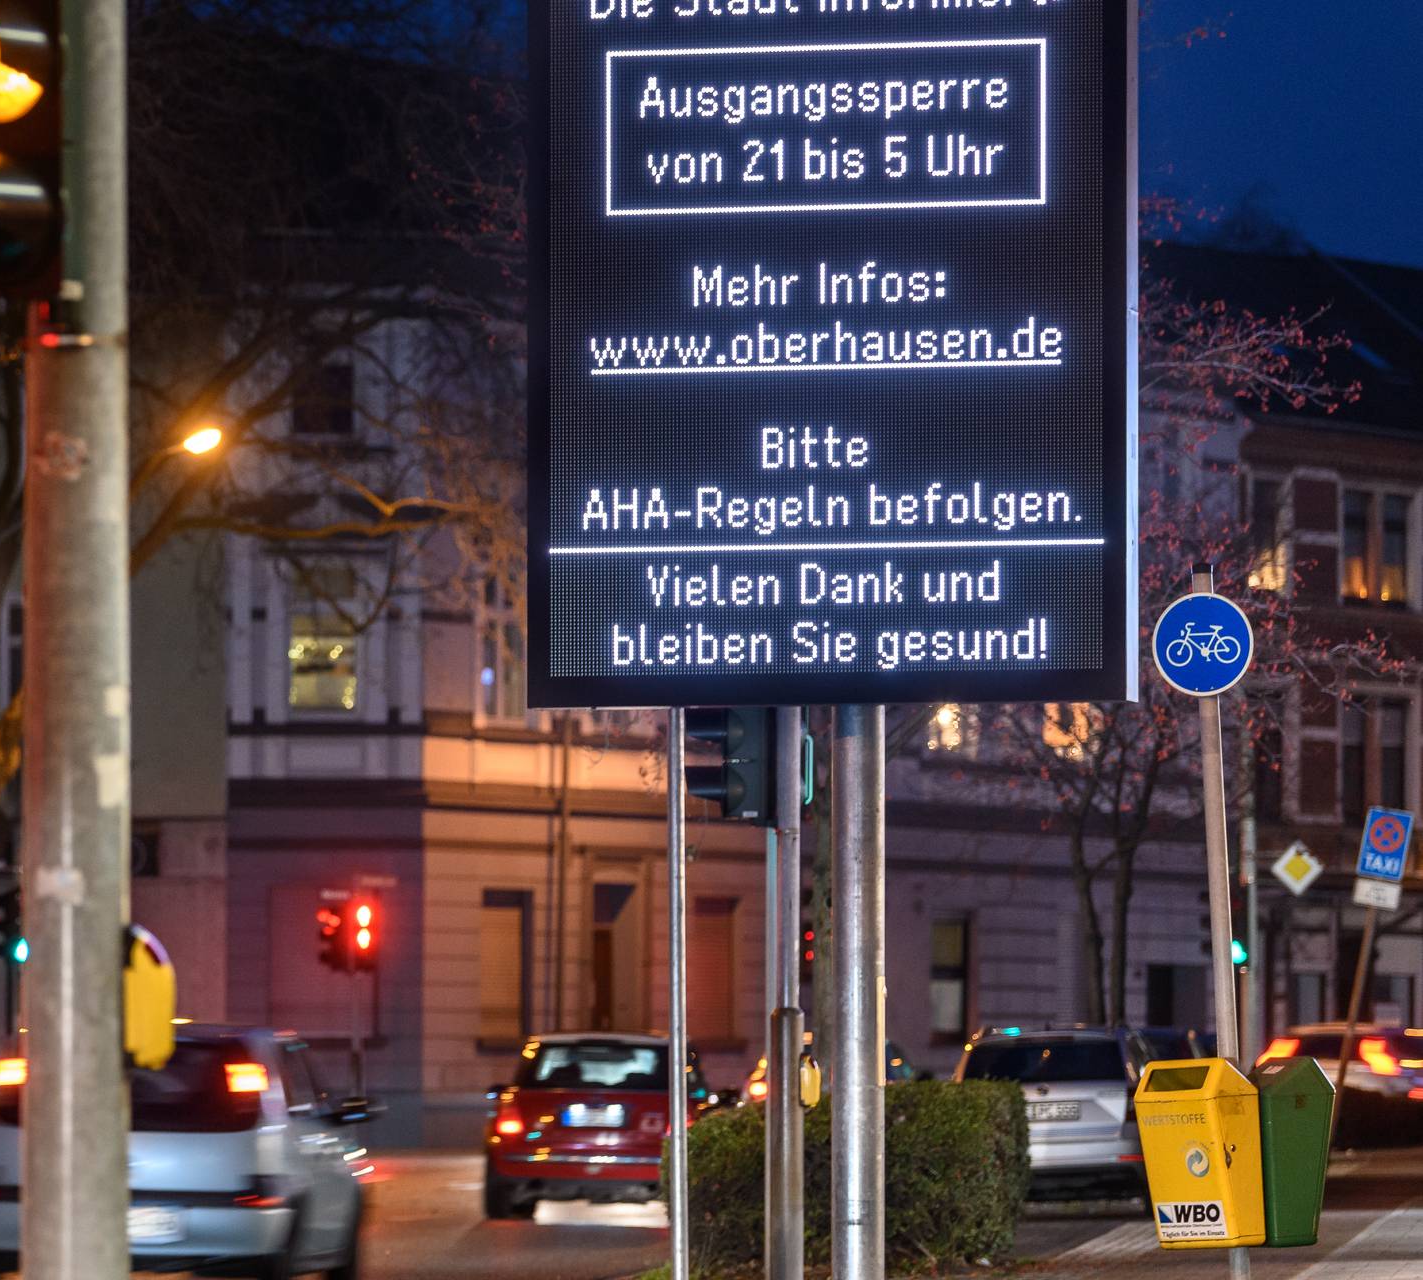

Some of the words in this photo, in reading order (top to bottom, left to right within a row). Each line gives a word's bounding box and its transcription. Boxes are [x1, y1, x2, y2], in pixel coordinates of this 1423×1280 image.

[639, 76, 1008, 123] Ausgangssperre
[647, 152, 722, 184] von
[742, 139, 784, 182] 21
[804, 138, 865, 180] bis
[884, 136, 907, 178] 5
[927, 134, 1004, 177] Uhr
[693, 264, 799, 308] Mehr
[819, 261, 946, 305] Infos:
[590, 316, 1063, 368] www.oberhausen.de
[761, 427, 869, 469] Bitte
[583, 485, 849, 536] AHA-Regeln
[869, 481, 1082, 531] befolgen.
[647, 564, 780, 607] Vielen
[800, 561, 903, 605] Dank
[923, 560, 1000, 603] und
[612, 622, 772, 667] bleiben
[792, 621, 857, 663] Sie
[877, 618, 1047, 669] gesund!
[1365, 852, 1400, 874] TAXI
[1142, 1113, 1206, 1126] WERTSTOFFE
[1174, 1203, 1220, 1223] WBO
